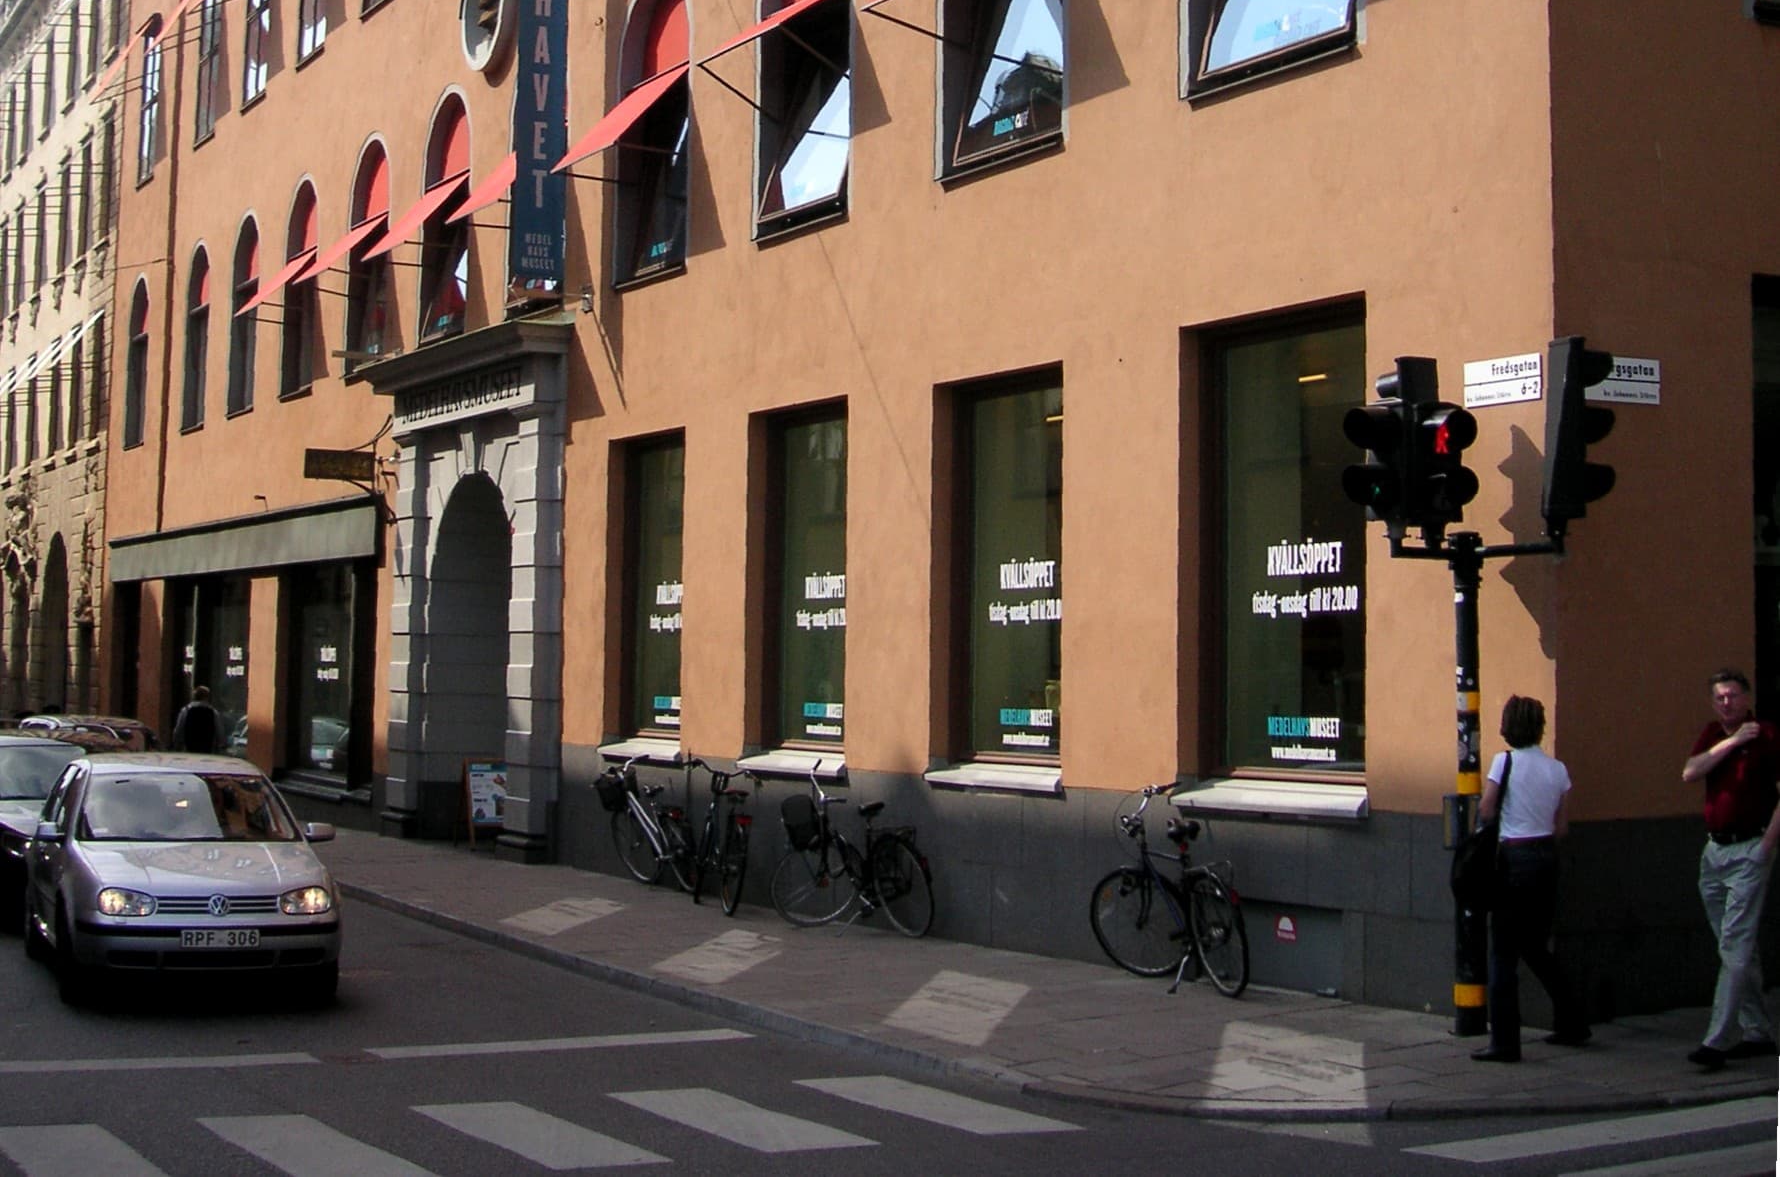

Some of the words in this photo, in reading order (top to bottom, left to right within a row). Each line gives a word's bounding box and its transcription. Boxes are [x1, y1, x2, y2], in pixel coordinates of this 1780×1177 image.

[1491, 360, 1538, 376] Fredsgatan
[1615, 364, 1655, 378] gsgatan
[1267, 538, 1342, 575] KVÄLLSÖPPET
[1331, 585, 1358, 611] 20.00
[183, 931, 216, 946] RPF
[227, 930, 258, 946] 306
